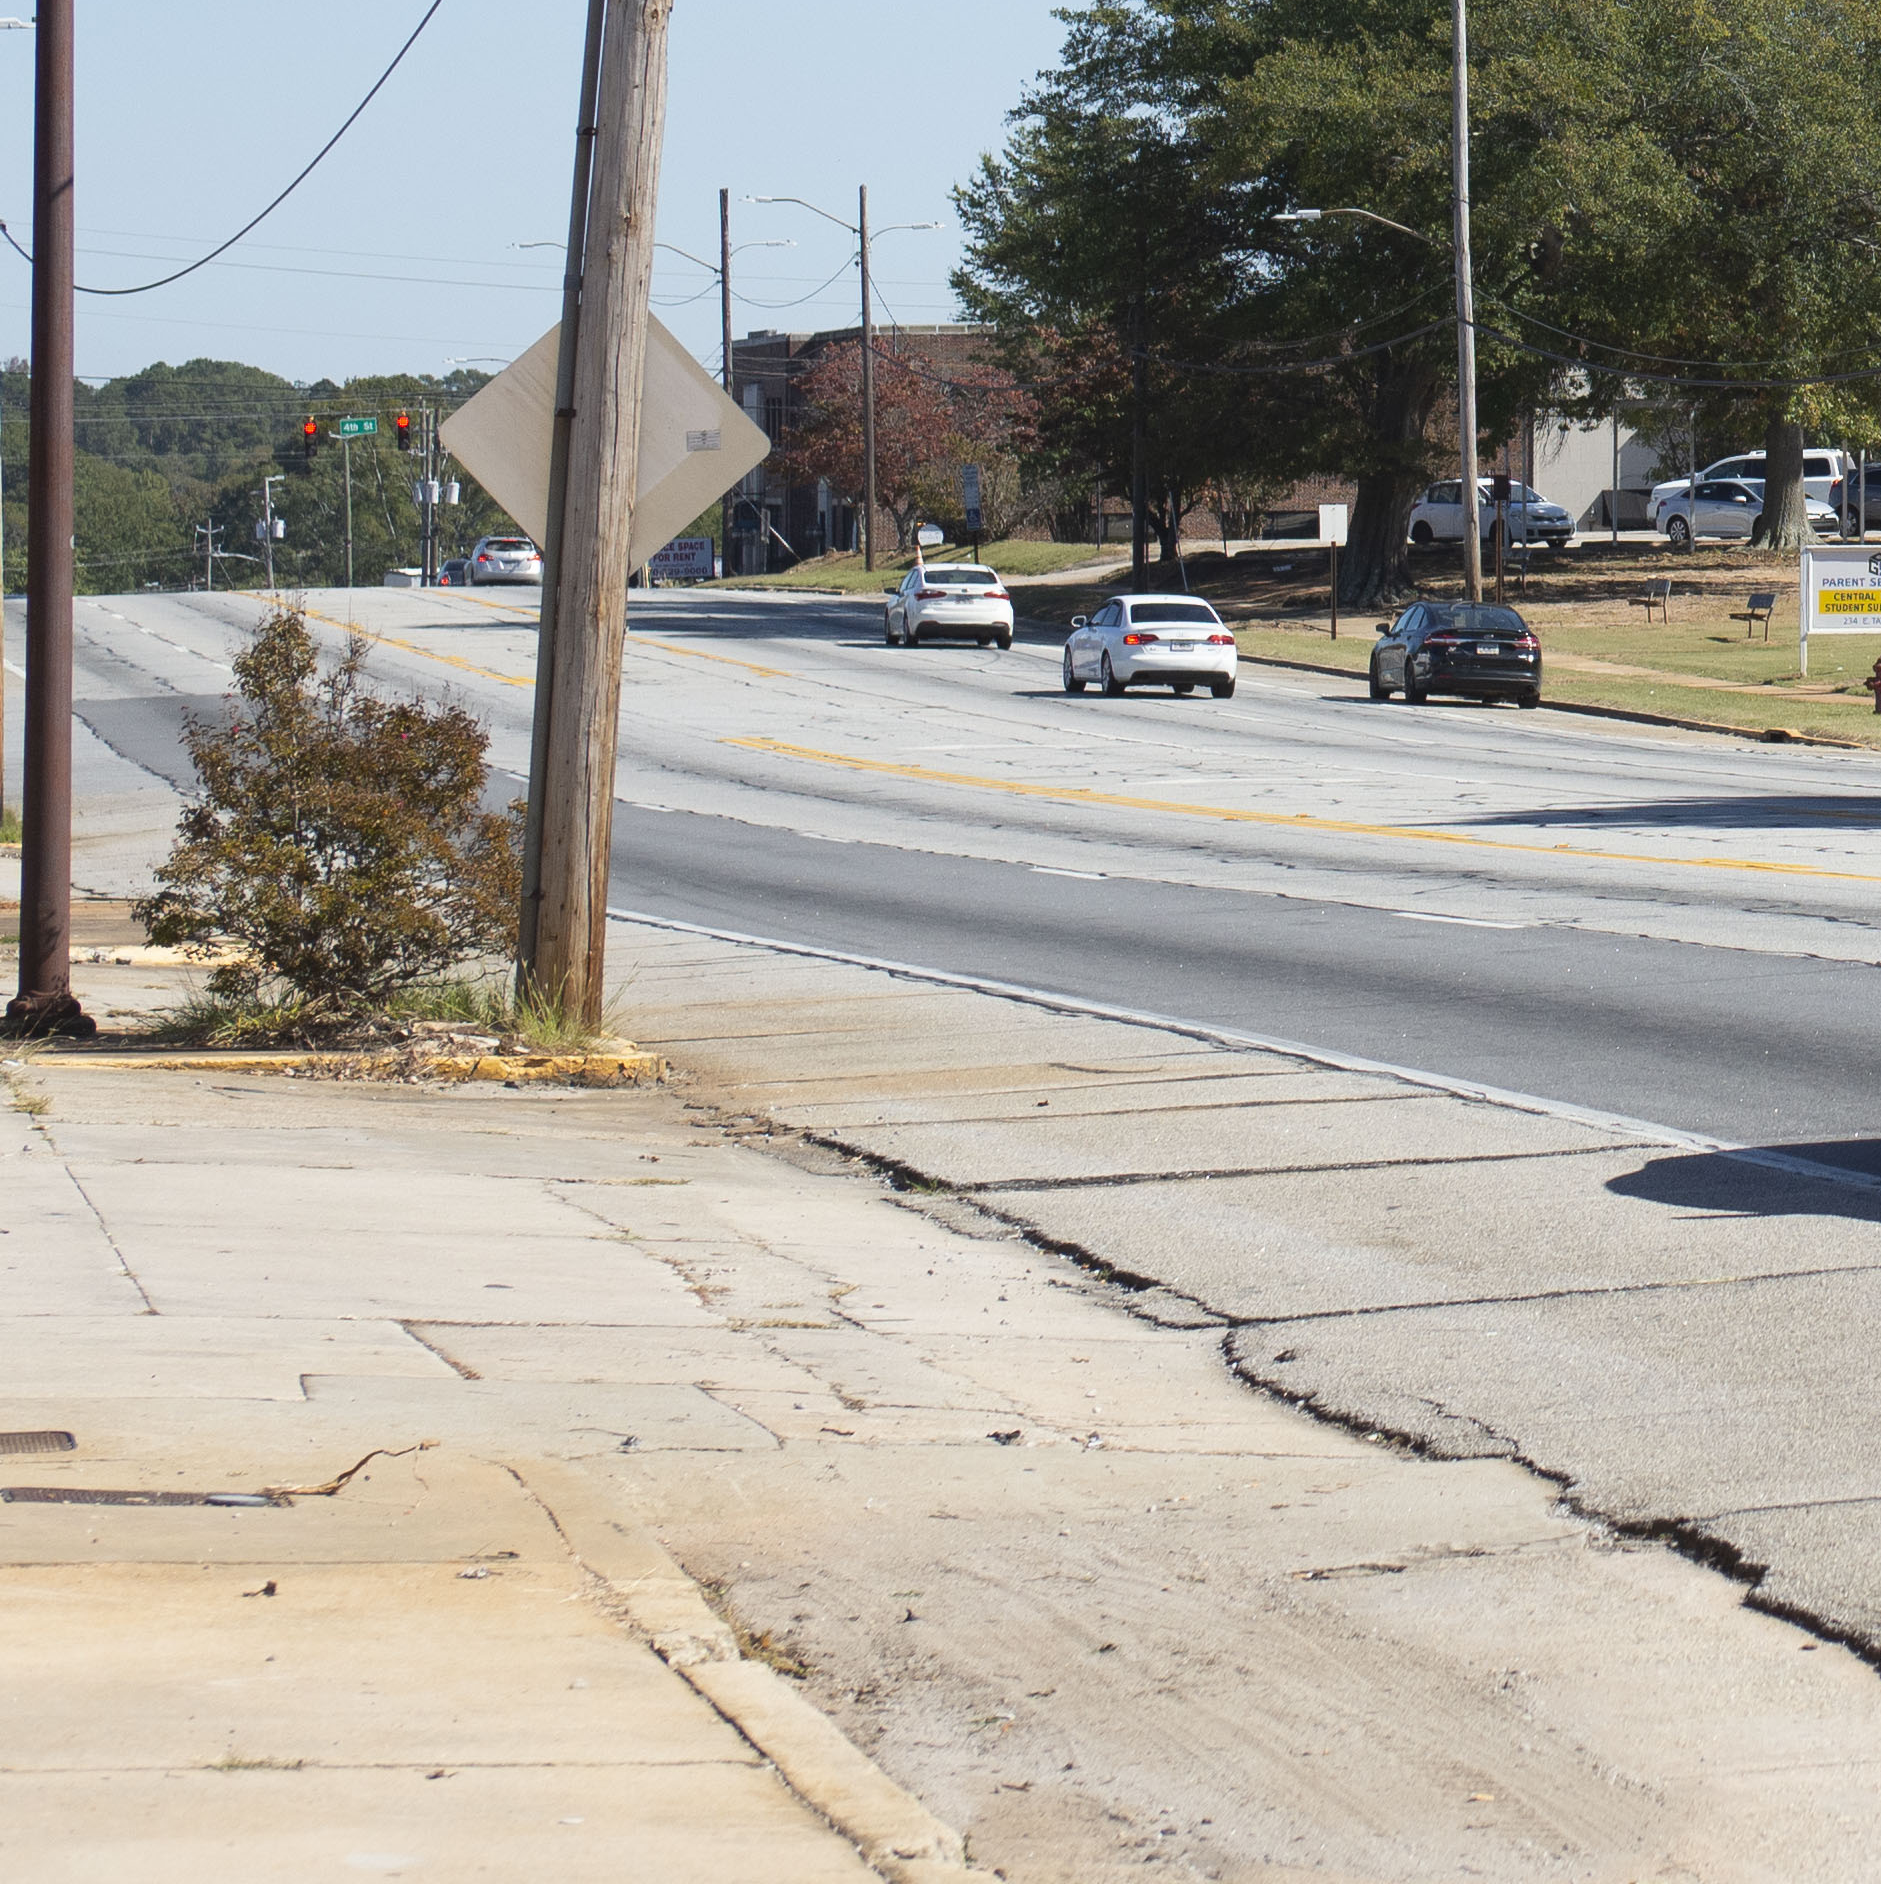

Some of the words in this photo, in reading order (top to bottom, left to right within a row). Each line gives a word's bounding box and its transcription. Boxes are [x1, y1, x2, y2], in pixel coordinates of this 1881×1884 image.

[343, 422, 359, 432] 4th
[678, 541, 705, 551] SPACE
[653, 554, 671, 562] FOR
[673, 552, 697, 562] RENT
[1822, 577, 1866, 587] PARENT
[1833, 592, 1877, 602] CENTRAL
[1825, 603, 1865, 613] STUDENT
[1843, 617, 1858, 625] 234
